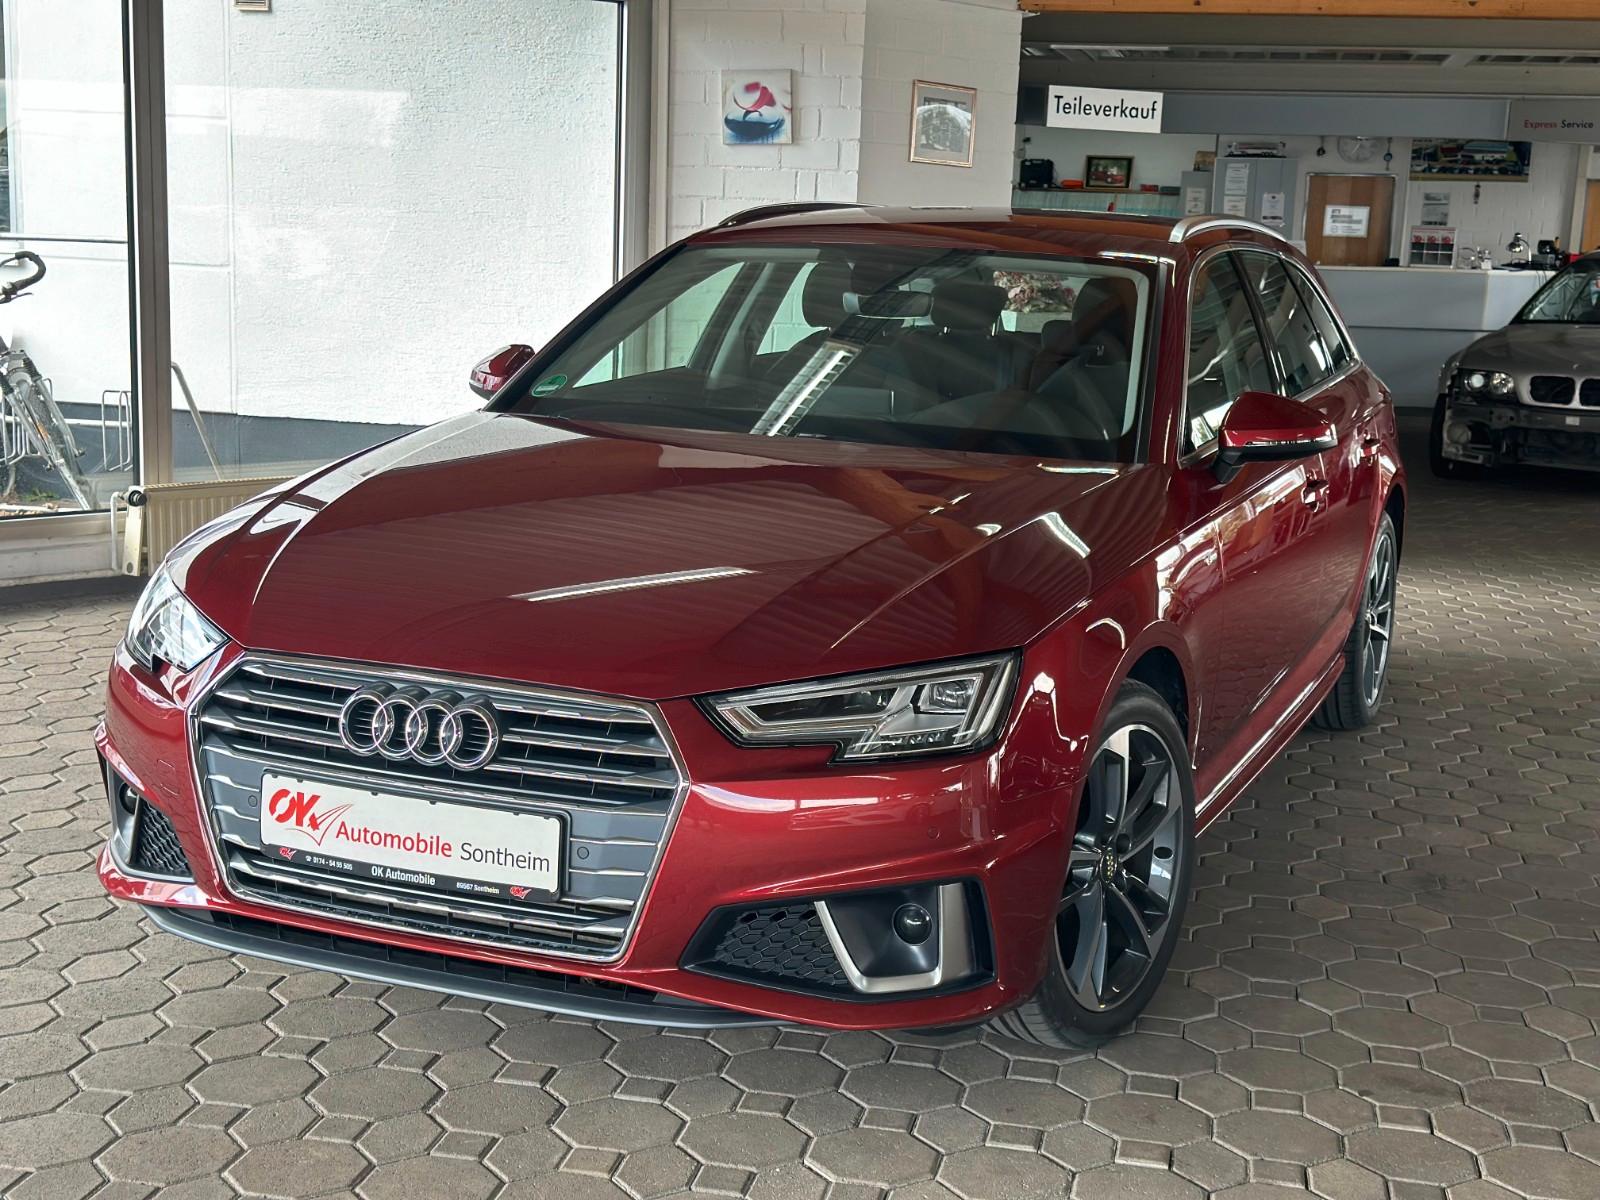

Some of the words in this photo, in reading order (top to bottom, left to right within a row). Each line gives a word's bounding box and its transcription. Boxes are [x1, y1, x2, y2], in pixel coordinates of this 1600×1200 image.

[1054, 95, 1158, 119] Teileverkauf
[1523, 119, 1558, 130] Express
[1561, 119, 1594, 129] Service
[269, 788, 320, 831] OK
[335, 821, 453, 858] Automobile
[460, 842, 550, 873] Sontheim
[371, 865, 384, 877] OK
[385, 868, 436, 887] Automobile
[473, 884, 500, 895] Sontheim
